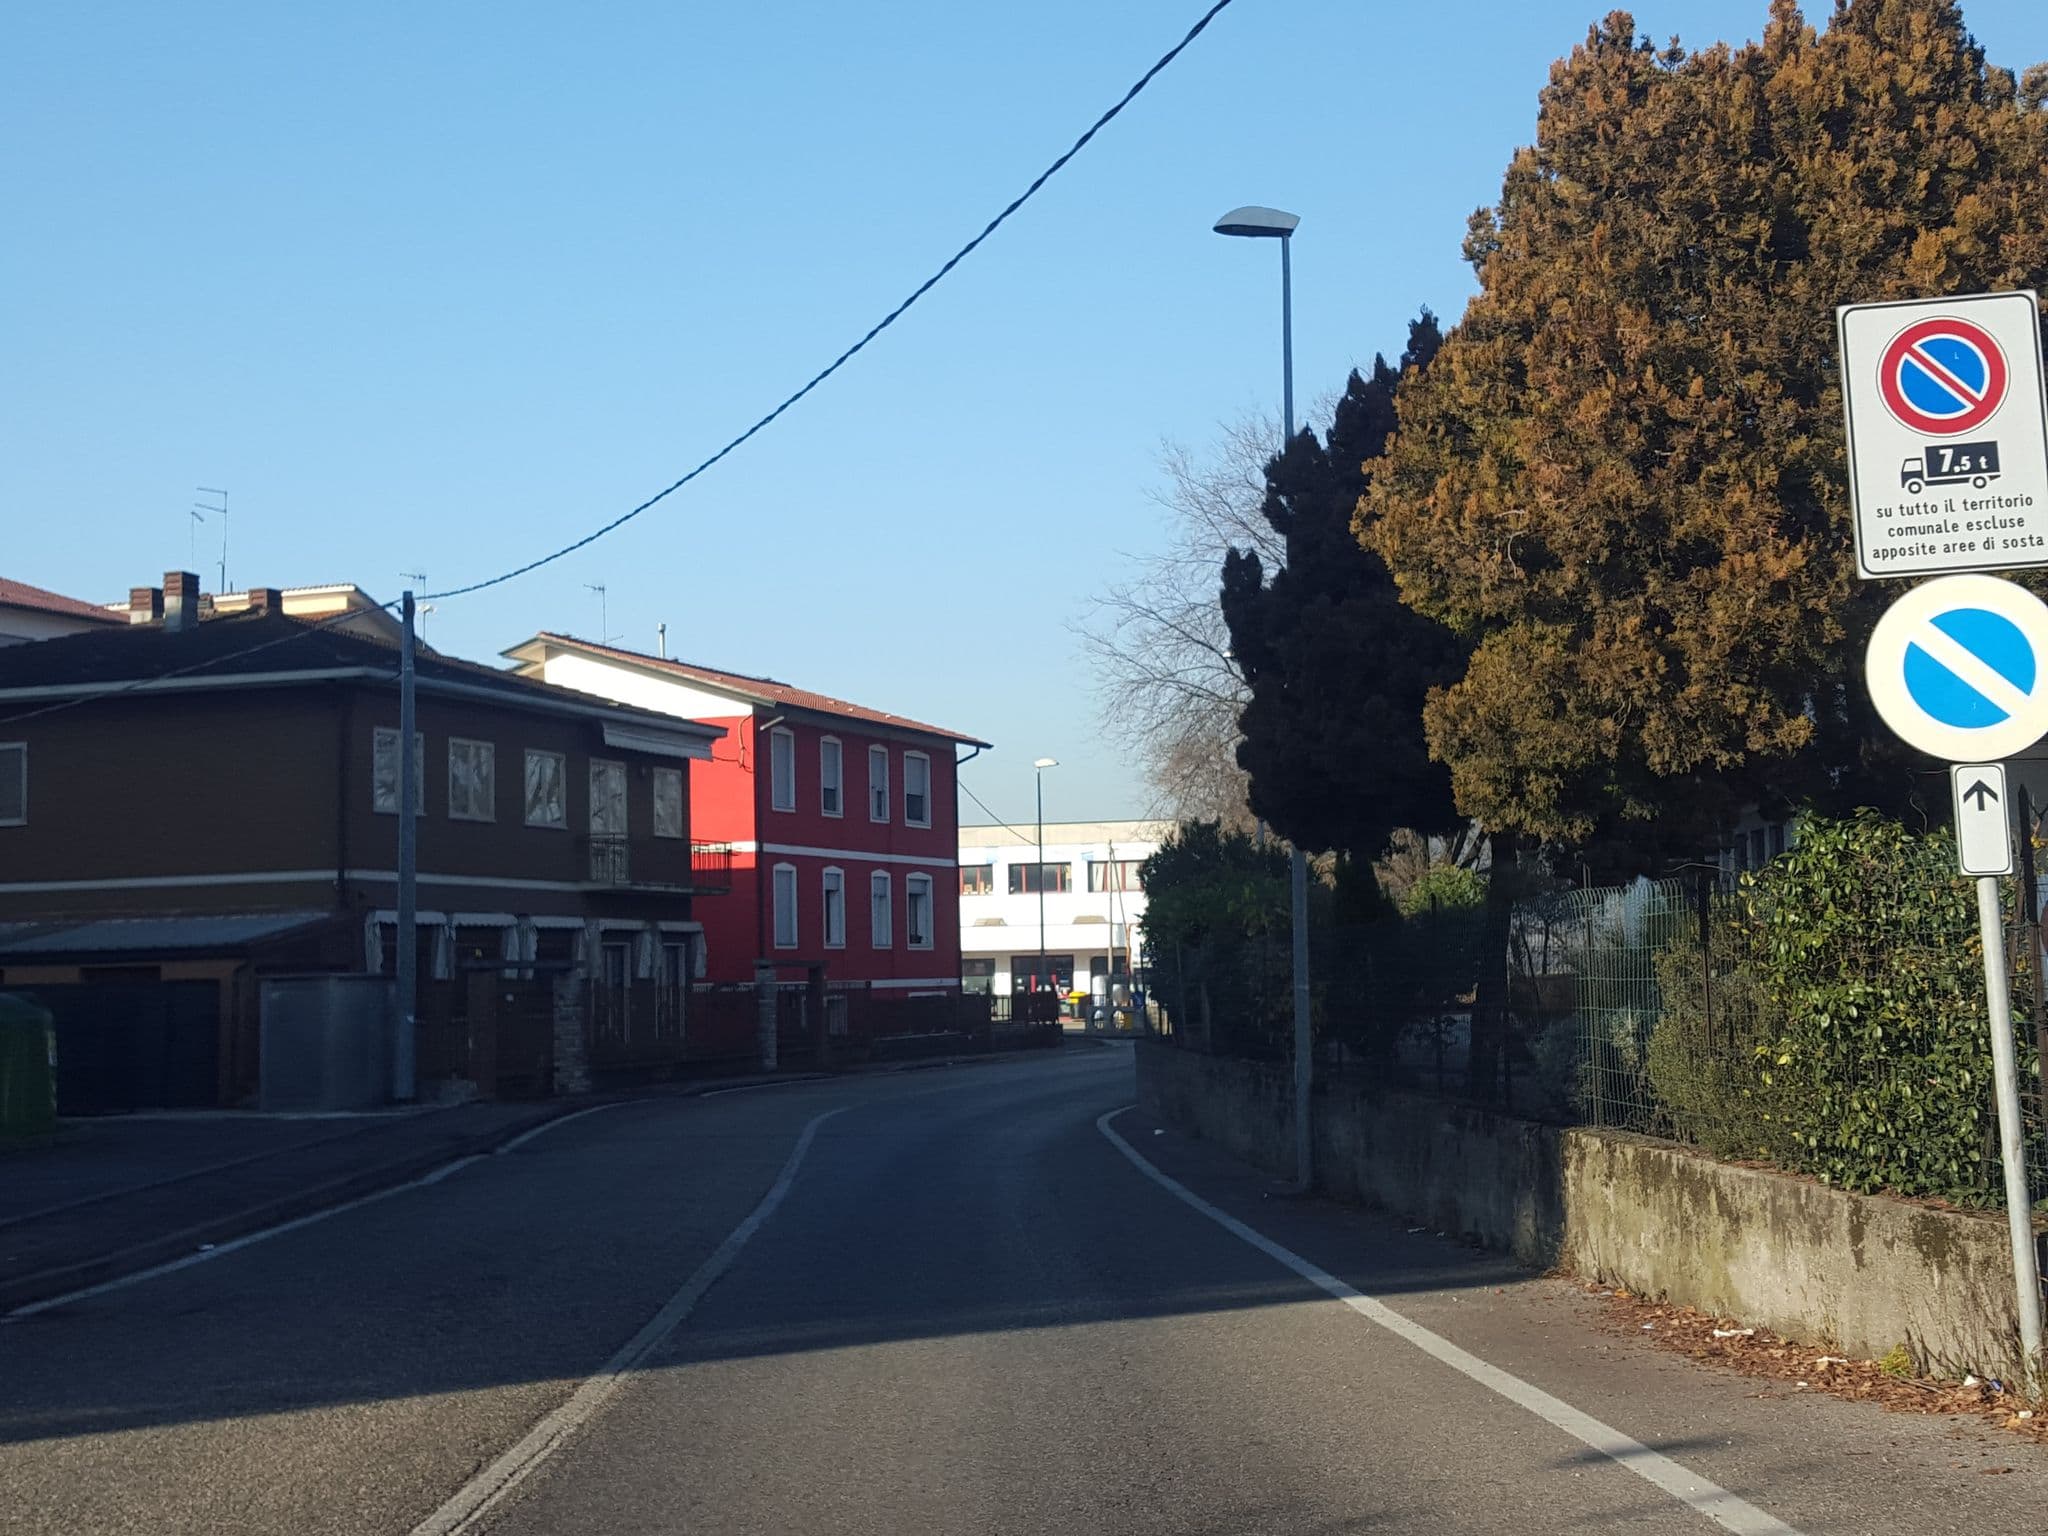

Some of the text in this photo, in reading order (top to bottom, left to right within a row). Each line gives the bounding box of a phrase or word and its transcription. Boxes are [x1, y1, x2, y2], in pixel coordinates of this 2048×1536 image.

[1939, 448, 1989, 473] 7.5 t
[1876, 493, 2033, 518] su tutto il territorio
[1887, 515, 2025, 537] comunale escluse
[1872, 534, 2044, 560] apposite aree di sosta
